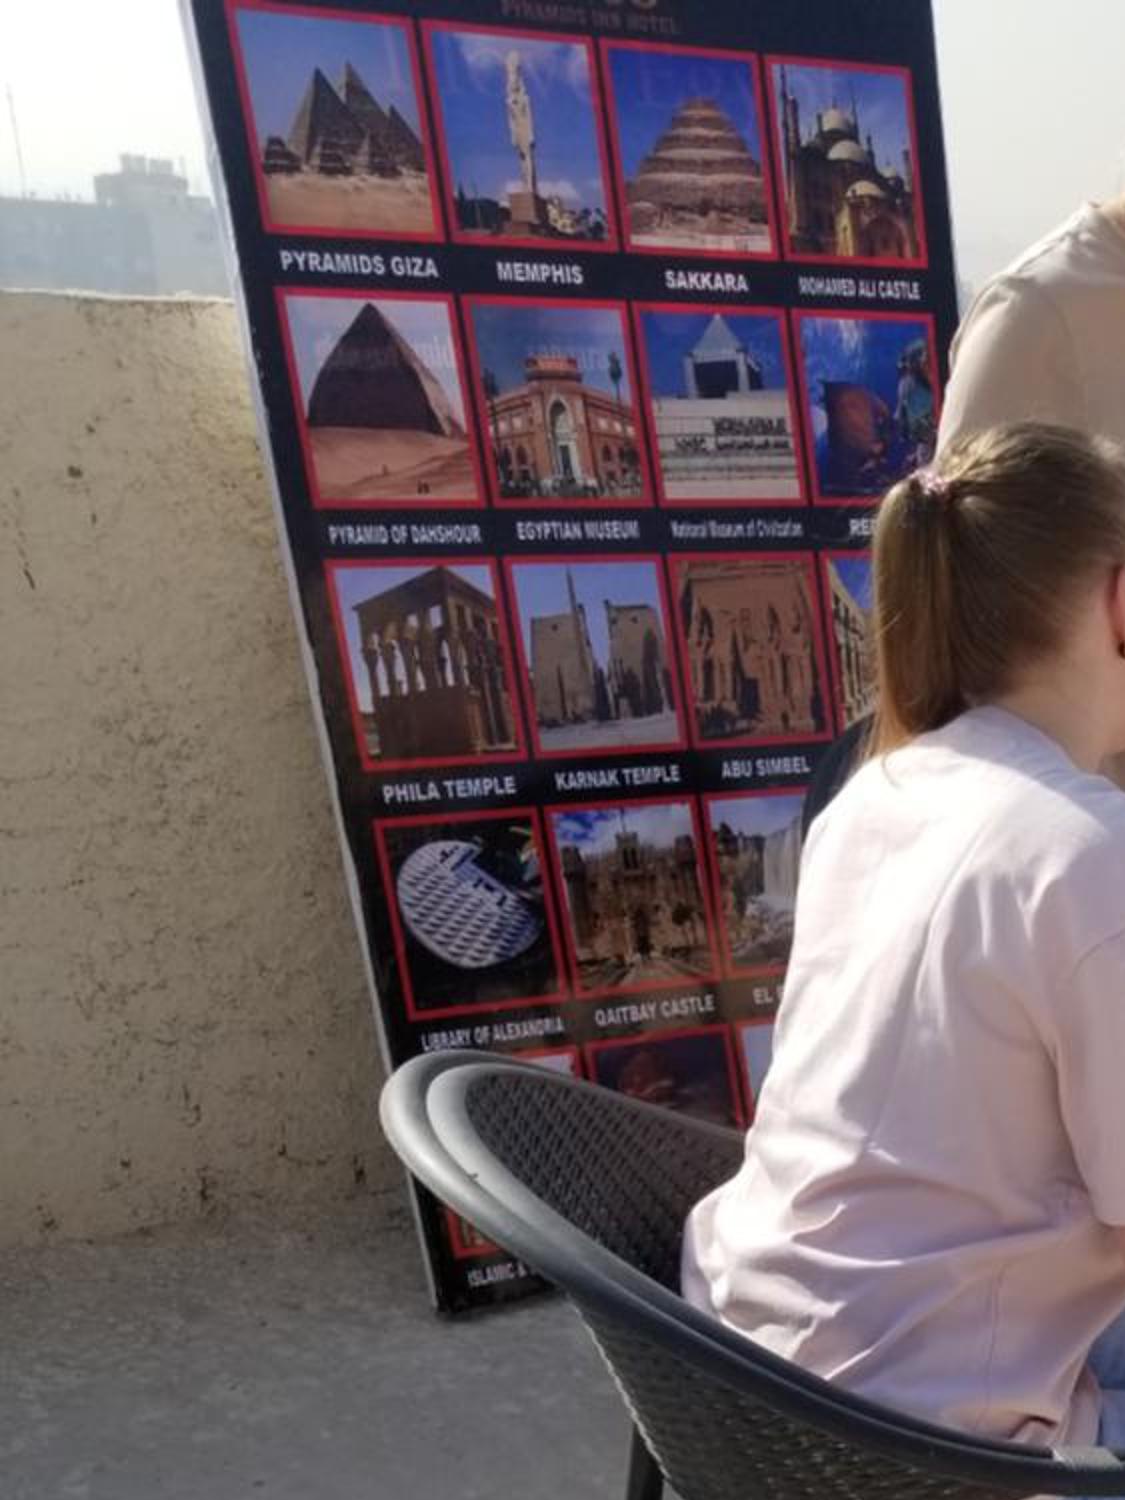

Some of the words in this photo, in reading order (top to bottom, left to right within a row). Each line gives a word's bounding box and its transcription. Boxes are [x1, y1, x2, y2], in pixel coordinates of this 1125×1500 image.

[280, 249, 384, 275] PYRAMIDS
[390, 256, 439, 278] GIZA
[496, 261, 583, 284] MEMPHIS
[664, 269, 749, 293] SAKKARA
[798, 275, 855, 297] MOHAMED
[858, 279, 876, 298] ALI
[878, 280, 920, 300] CASTLE
[328, 524, 388, 544] PYRAMID
[390, 524, 408, 544] OF
[411, 524, 482, 545] DAHSHOUR
[516, 520, 582, 541] EGYPTIAN
[585, 519, 640, 540] MUSEUM
[554, 767, 619, 791] KARNAK
[622, 764, 680, 787] TEMPLE
[721, 759, 753, 780] ABU
[755, 755, 811, 777] SIMBEL
[383, 781, 440, 804] PHILA
[443, 775, 516, 799] TEMPLE
[753, 986, 774, 1005] EL
[594, 1000, 657, 1028] QAITBAY
[659, 994, 716, 1018] CASTLE
[421, 1026, 471, 1052] LIBRARY
[472, 1025, 493, 1045] OF
[493, 1015, 565, 1043] ALEXANDRIA
